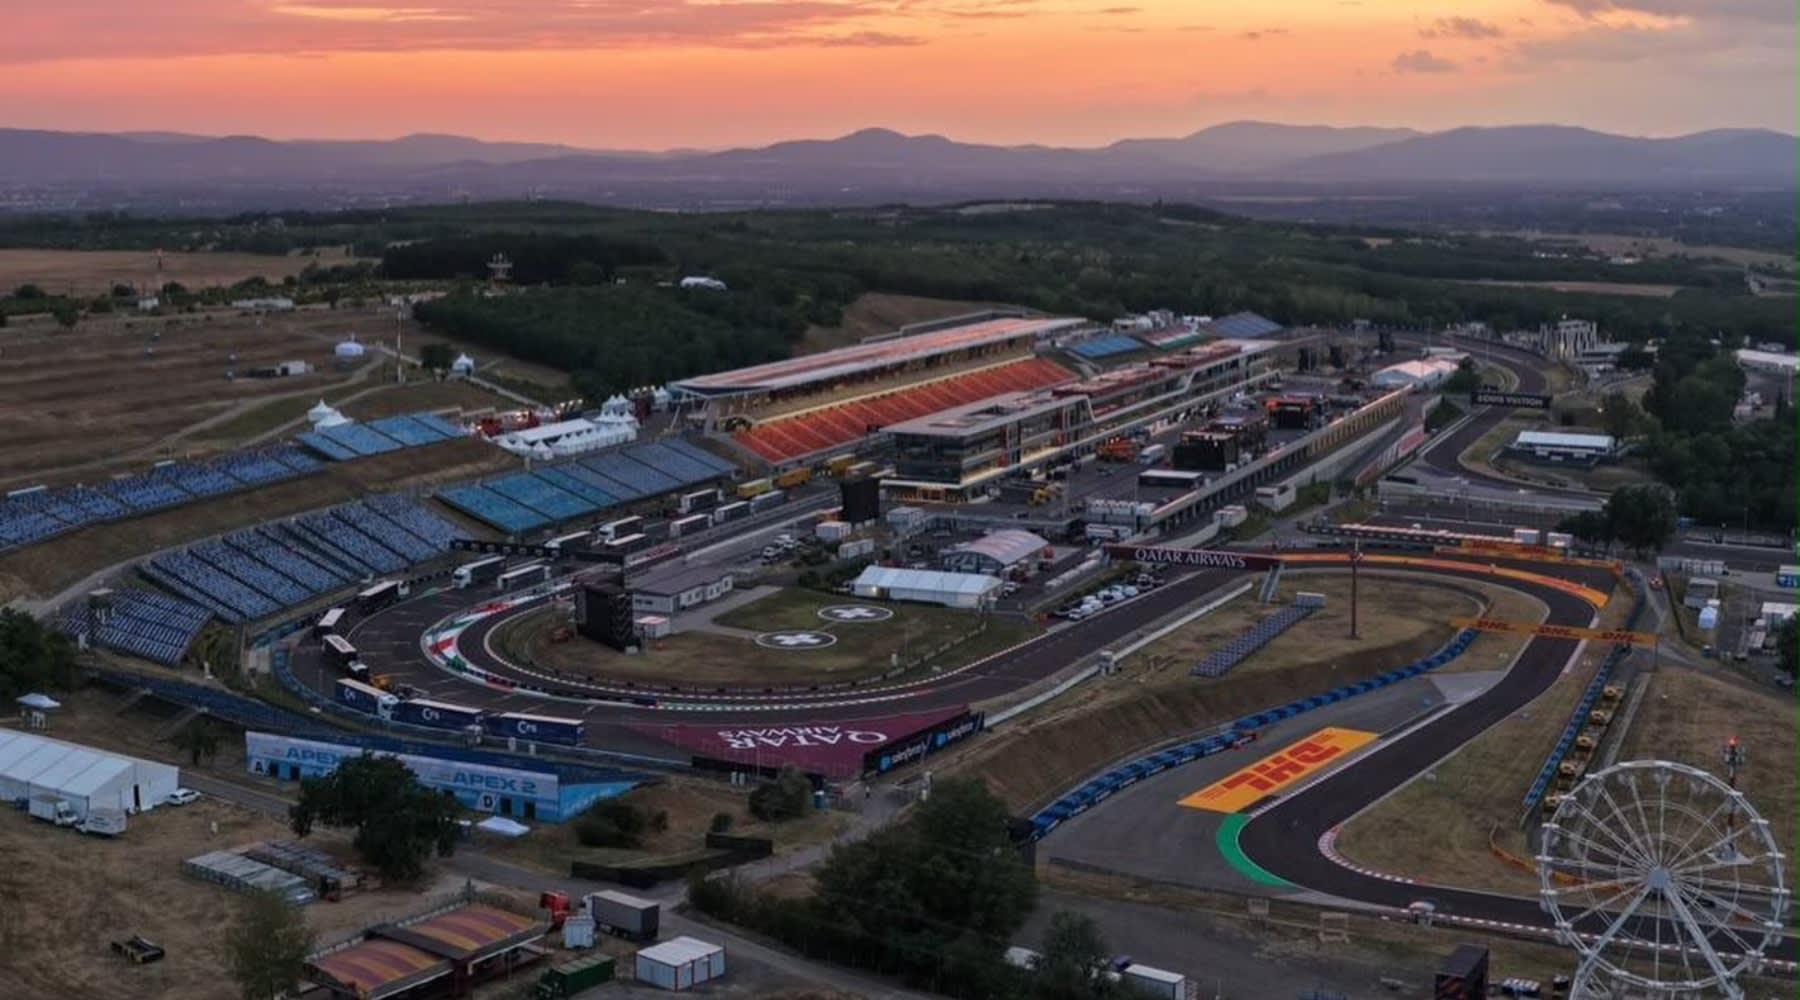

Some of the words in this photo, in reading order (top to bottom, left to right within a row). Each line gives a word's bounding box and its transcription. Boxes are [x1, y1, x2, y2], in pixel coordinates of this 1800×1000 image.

[1135, 549, 1182, 562] QATAR
[1186, 553, 1246, 568] AIRWAYS
[718, 725, 841, 739] AIRWAYS
[731, 730, 888, 750] QATAR
[1221, 741, 1342, 792] DHL
[453, 771, 518, 792] APEX
[521, 782, 537, 793] 2
